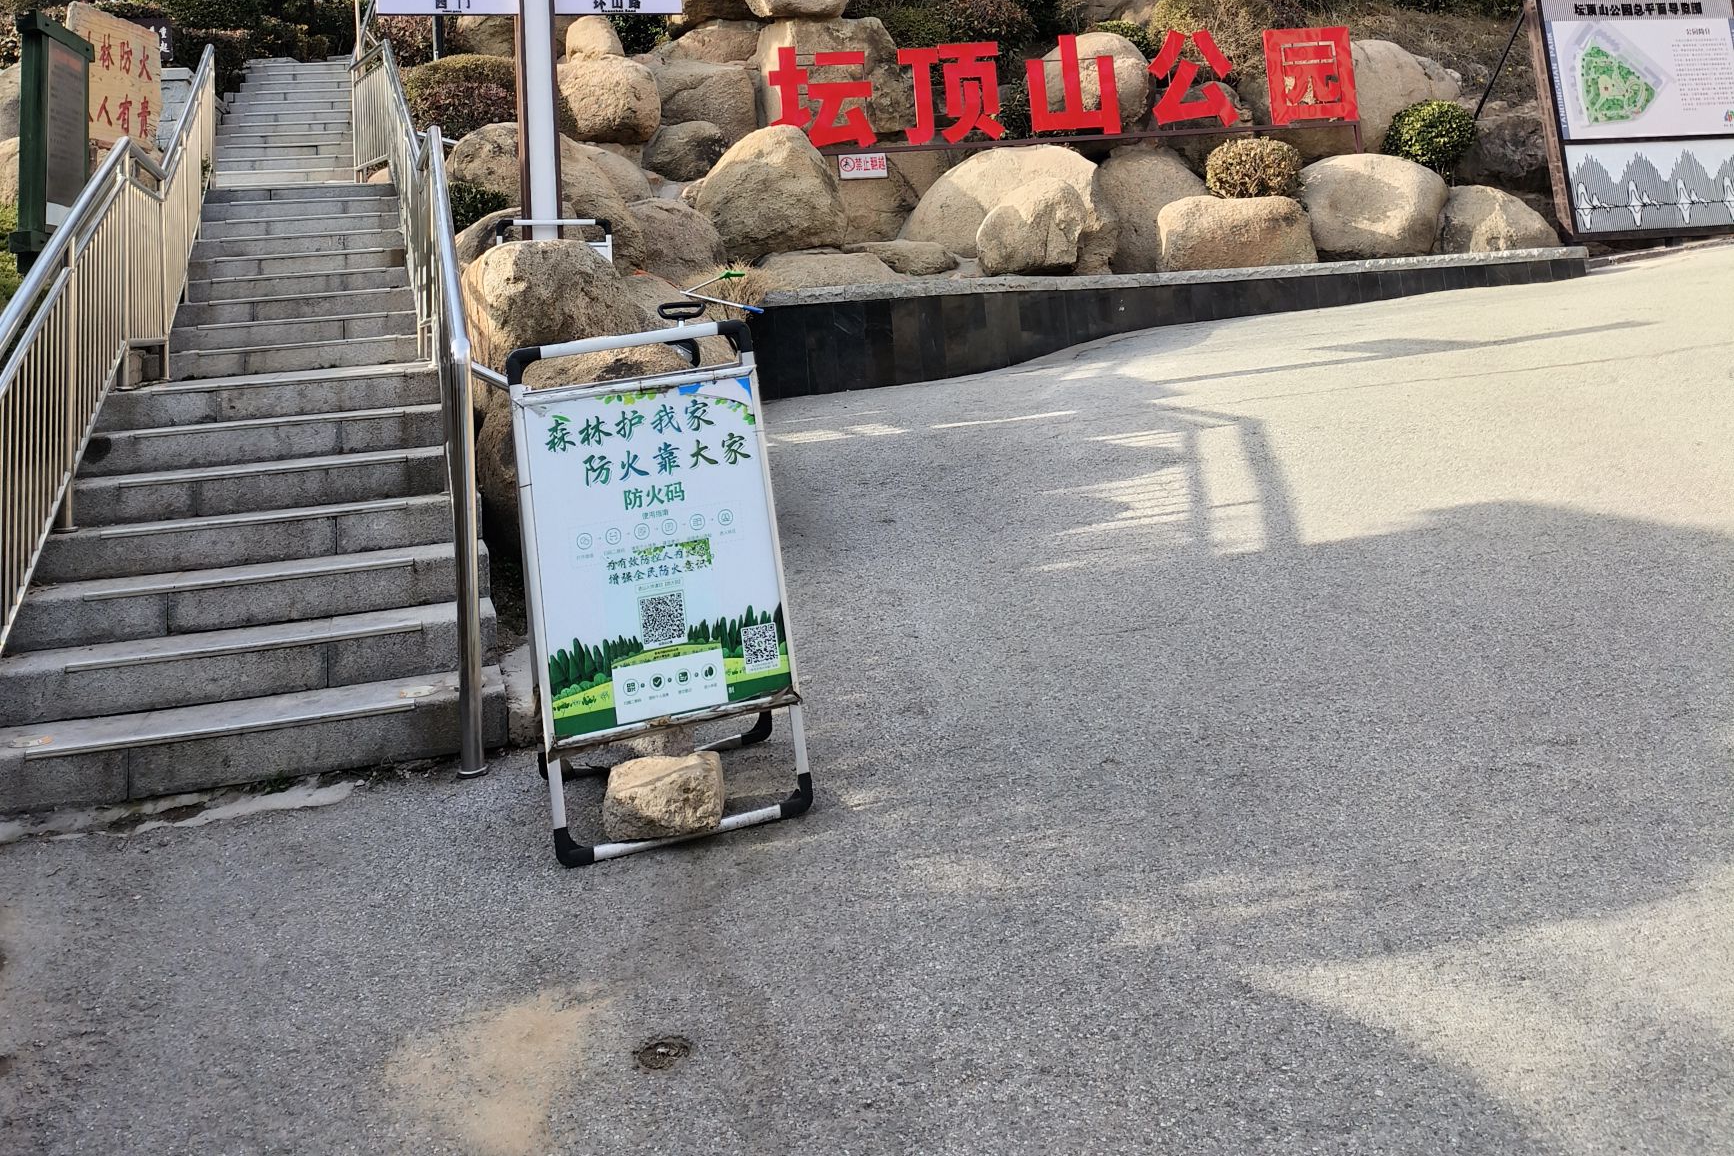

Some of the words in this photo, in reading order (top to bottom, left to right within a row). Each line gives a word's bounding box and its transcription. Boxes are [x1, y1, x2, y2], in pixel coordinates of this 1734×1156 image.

[87, 31, 152, 81] 林防火
[769, 26, 1360, 147] 坛顶山公园
[87, 94, 152, 139] 人有责
[544, 399, 715, 452] 森林护我家
[583, 432, 751, 486] 防火靠大家
[623, 481, 686, 511] 防火码
